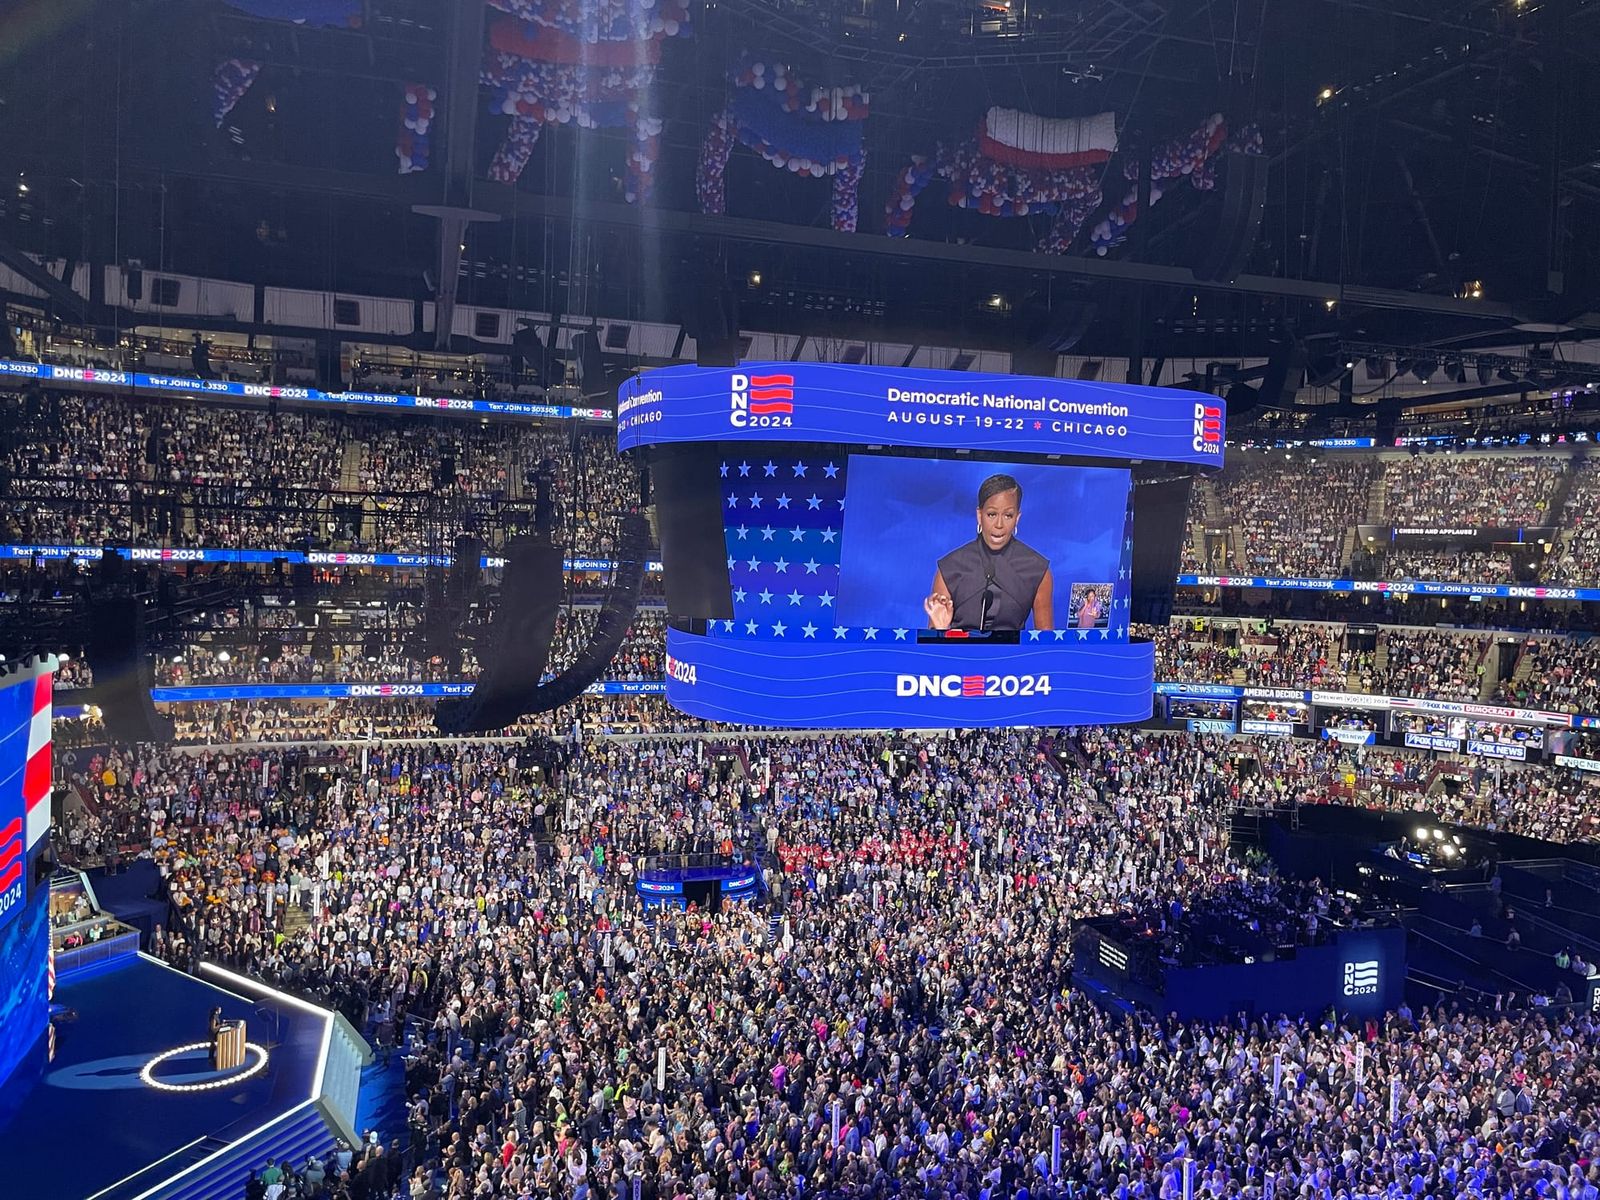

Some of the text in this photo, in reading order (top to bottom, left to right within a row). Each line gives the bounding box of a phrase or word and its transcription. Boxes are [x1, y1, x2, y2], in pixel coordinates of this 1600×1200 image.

[9, 365, 39, 375] 30330
[94, 370, 127, 383] 2024
[149, 377, 168, 386] Text
[168, 379, 191, 389] JOIN
[191, 381, 200, 389] to
[281, 388, 309, 398] 2024
[373, 395, 398, 404] 30330
[448, 399, 474, 410] 2024
[730, 374, 793, 428] DNC 2024
[887, 388, 1129, 418] Democratic National Convention
[887, 411, 1128, 437] AUGUST 19-22 CHICAGO
[1202, 441, 1220, 455] 2024
[131, 549, 205, 560] DNC 2024
[308, 553, 376, 564] DNC 2024
[1198, 577, 1253, 586] DNC 2024
[1353, 581, 1415, 591] DNC 2024
[1441, 585, 1461, 593] JOIN
[1471, 586, 1498, 594] 30330
[1509, 587, 1577, 599] DNC 2024
[674, 659, 697, 686] 2024
[351, 684, 424, 695] DNC 2024
[442, 685, 461, 694] Text
[622, 684, 643, 692] Text
[643, 684, 660, 692] JOIN
[896, 675, 1052, 698] DNC 2024
[1187, 684, 1212, 694] NEWS
[1243, 688, 1305, 700] AMERICA DECIDES
[1441, 703, 1463, 711] NEWS
[1466, 705, 1514, 717] DEMOCRACY
[1201, 721, 1233, 731] NEWS
[1414, 735, 1459, 748] FOX NEWS
[1477, 743, 1524, 756] FOX NEWS
[1343, 962, 1377, 996] DNC 2024
